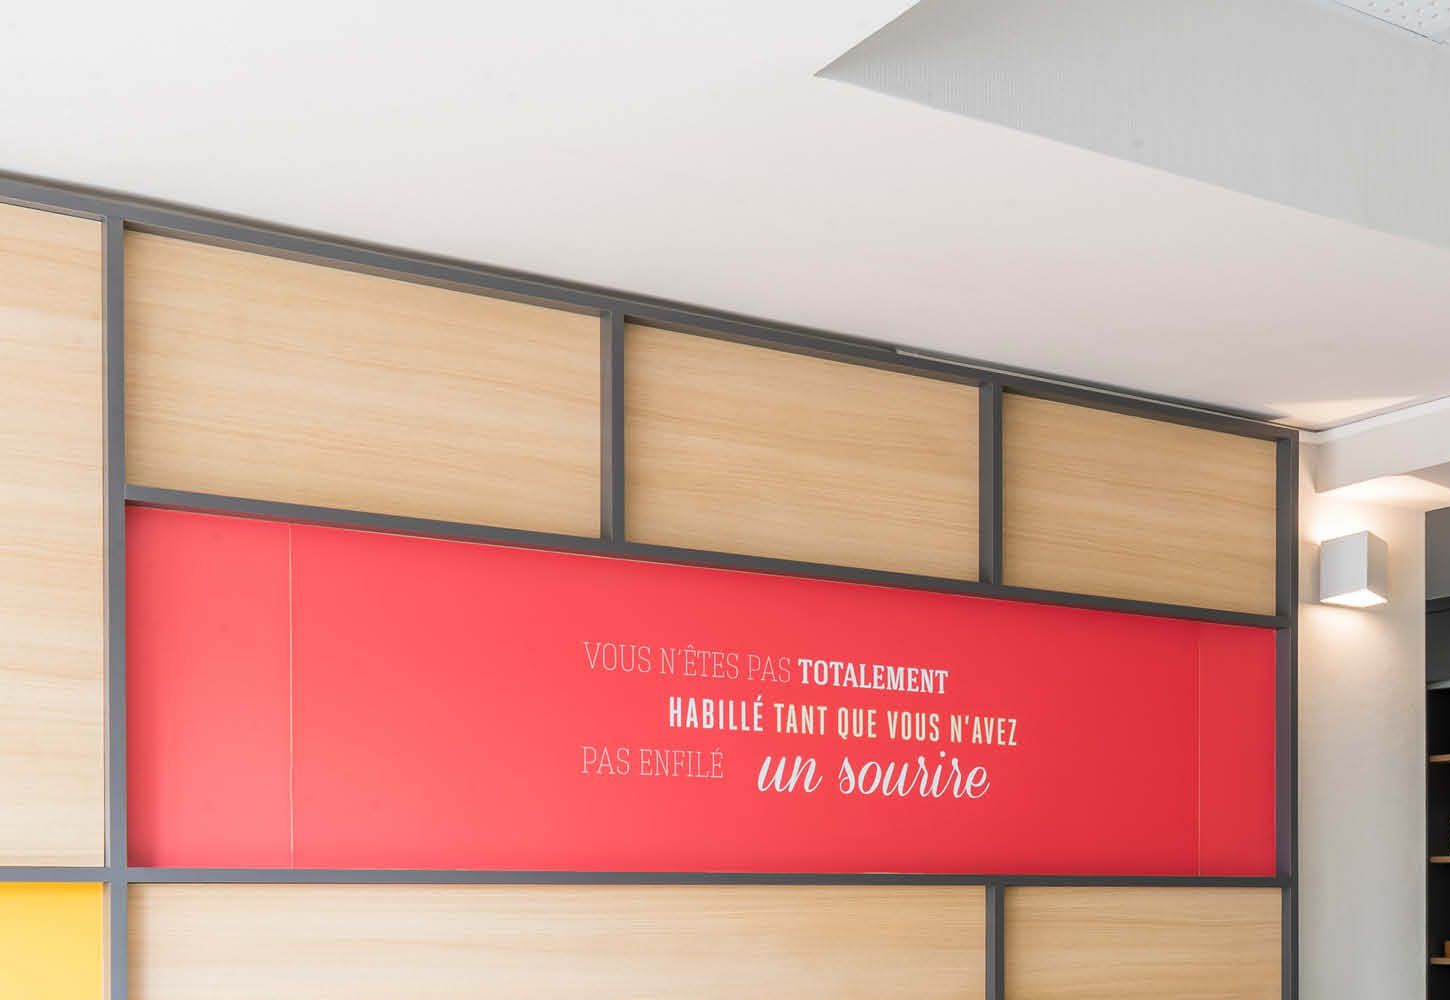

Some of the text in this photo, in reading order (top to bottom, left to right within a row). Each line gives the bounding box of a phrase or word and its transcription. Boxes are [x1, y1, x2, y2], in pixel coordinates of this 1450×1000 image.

[584, 641, 949, 694] VOUS N'ÊTES PAS TOTALEMENT
[669, 694, 1017, 746] HABILLÉ TANT QUE VOUS N'AVEZ
[581, 746, 991, 799] PAS ENFILÉ un sourire
